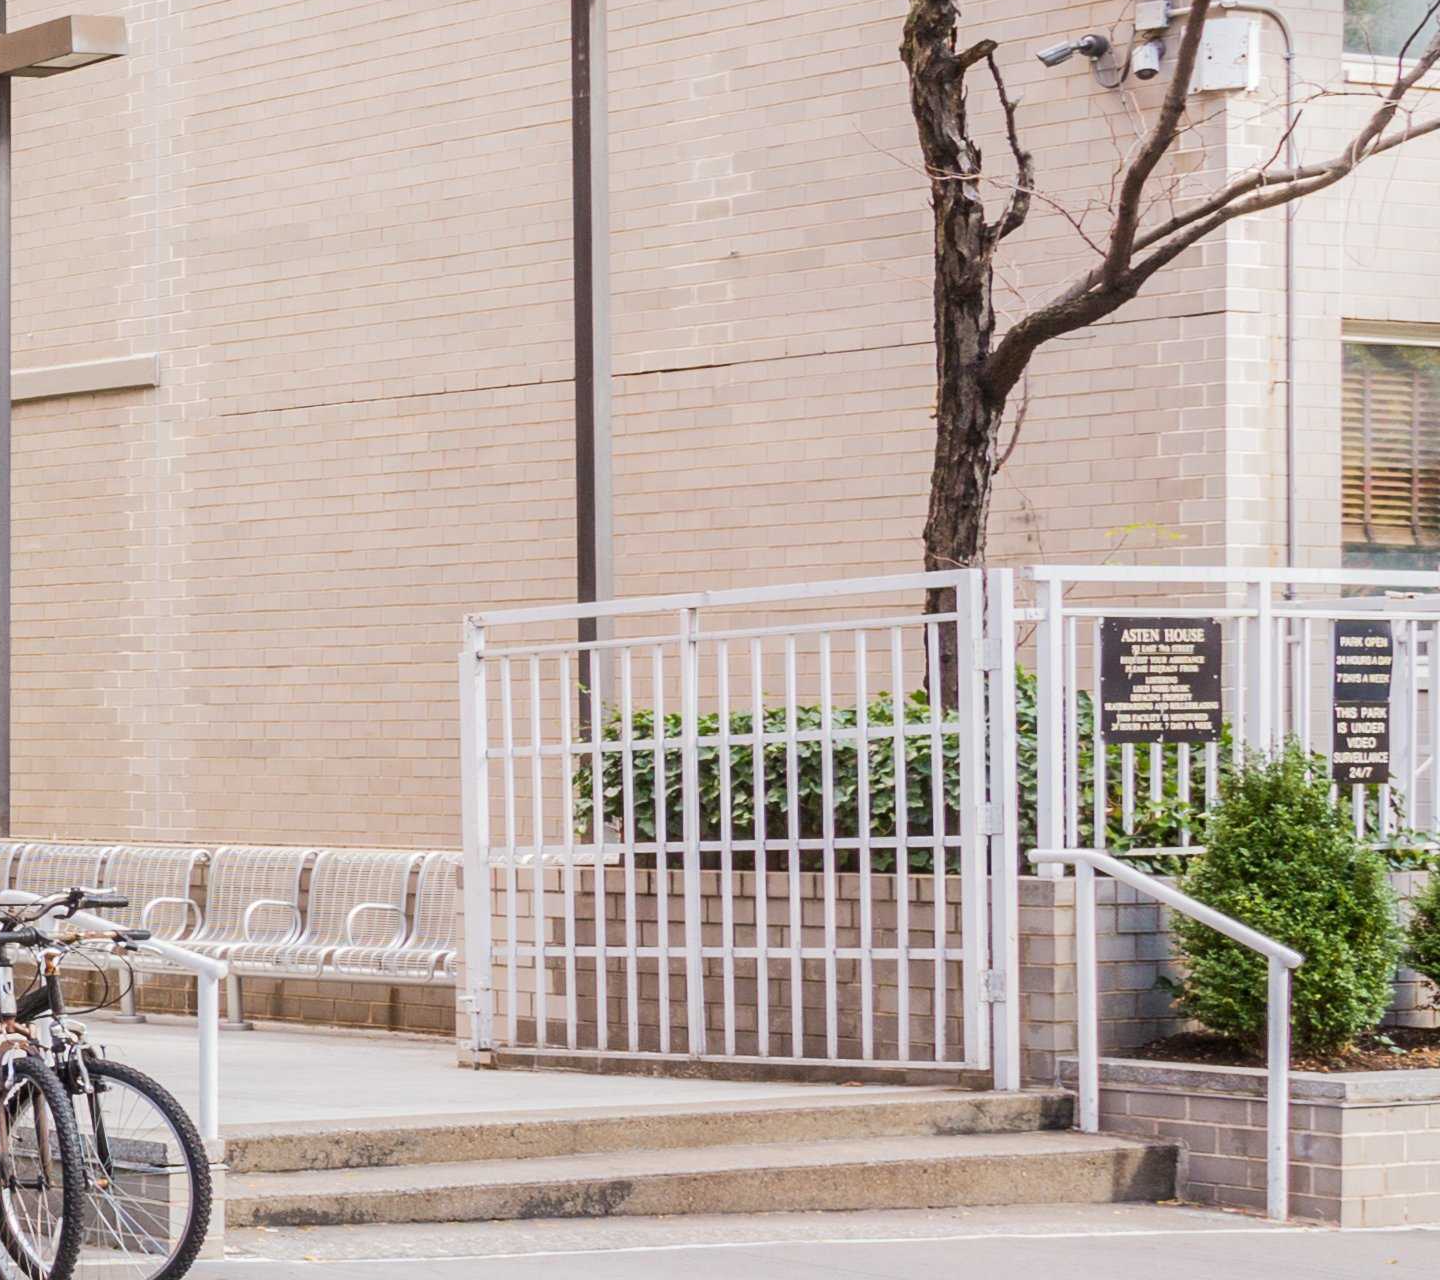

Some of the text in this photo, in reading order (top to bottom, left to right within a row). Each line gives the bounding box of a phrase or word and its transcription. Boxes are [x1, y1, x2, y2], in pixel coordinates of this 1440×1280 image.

[1121, 628, 1205, 642] ASTEN HOUSE
[1339, 636, 1389, 648] PARK OPEN
[1346, 655, 1371, 665] HOURS
[1371, 655, 1377, 665] A
[1378, 655, 1393, 665] DAY
[1336, 673, 1390, 683] 7 DAYS A WEEK
[1335, 707, 1387, 719] THIS PARK
[1337, 722, 1385, 734] IS UNDER
[1346, 736, 1377, 749] VIDEO
[1333, 751, 1389, 764] SURVEILLANCE
[1349, 766, 1373, 779] 24/7
